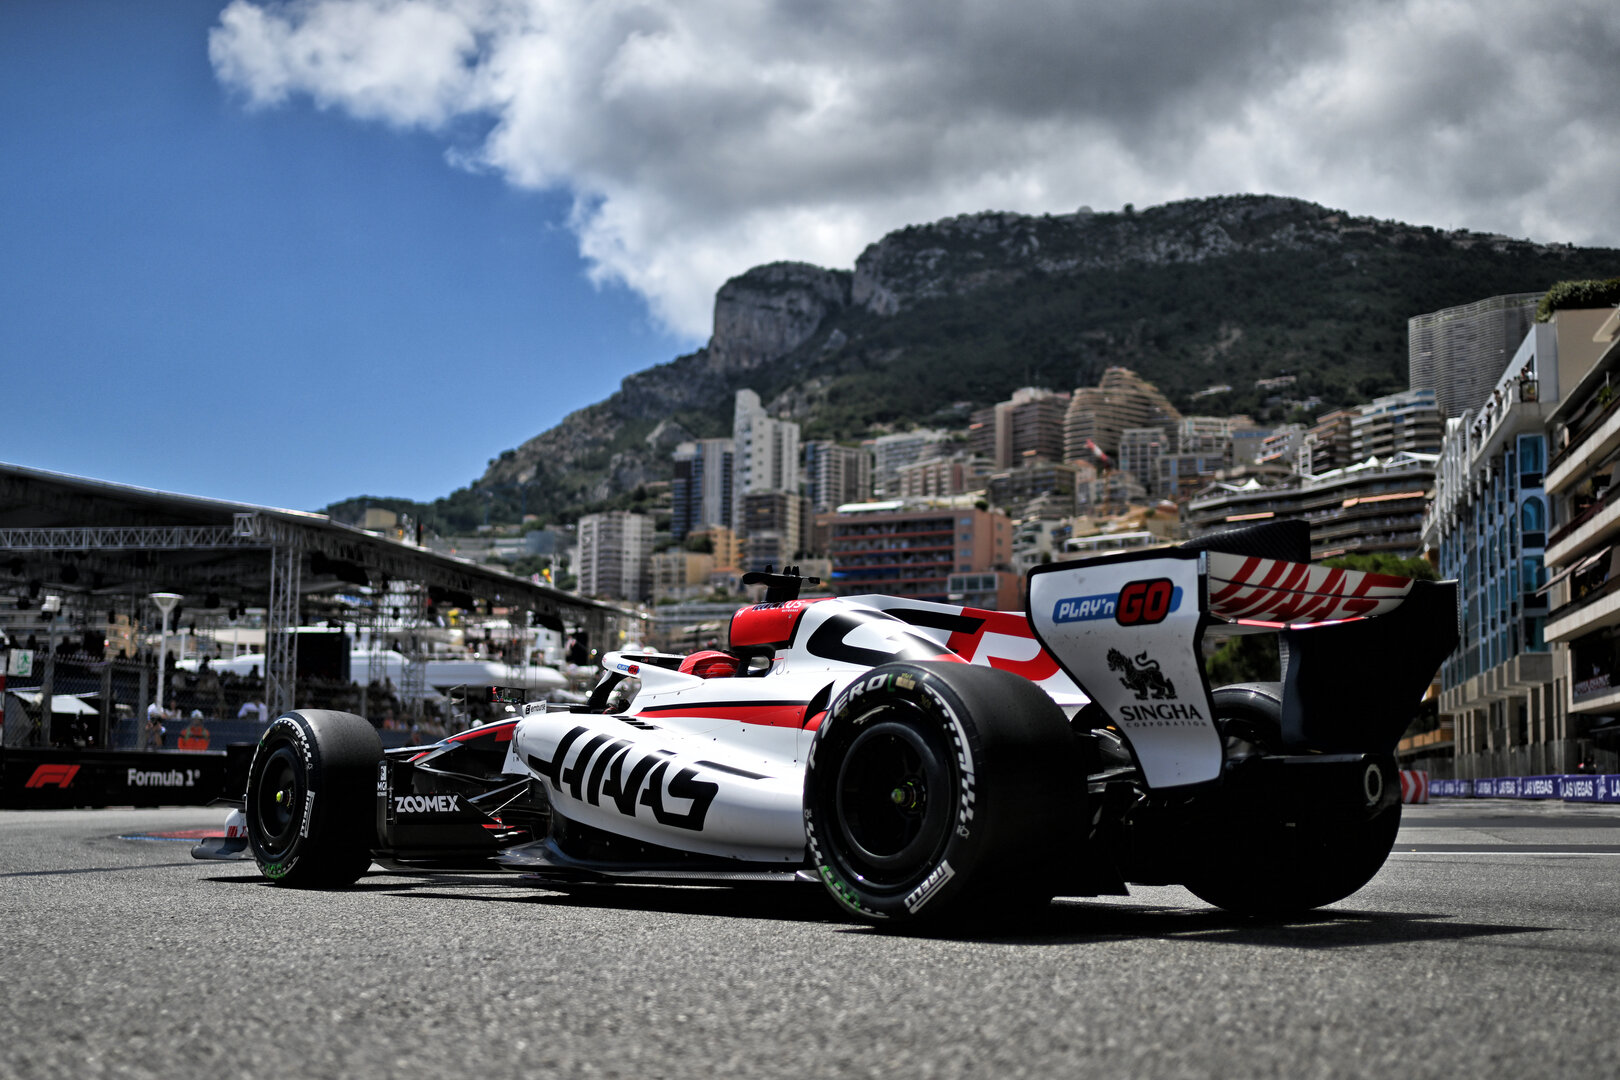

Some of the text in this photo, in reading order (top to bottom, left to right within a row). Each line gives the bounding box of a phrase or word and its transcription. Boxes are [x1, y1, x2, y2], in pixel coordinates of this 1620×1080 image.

[1119, 580, 1171, 623] GO
[820, 673, 889, 739] ZERO
[1120, 704, 1203, 721] SINGHA
[127, 768, 184, 786] Formula
[1532, 779, 1553, 795] VEGAS
[1563, 780, 1593, 797] LAS VEGAS
[395, 795, 460, 813] ZOOMEX
[904, 859, 956, 914] PIRELLI
